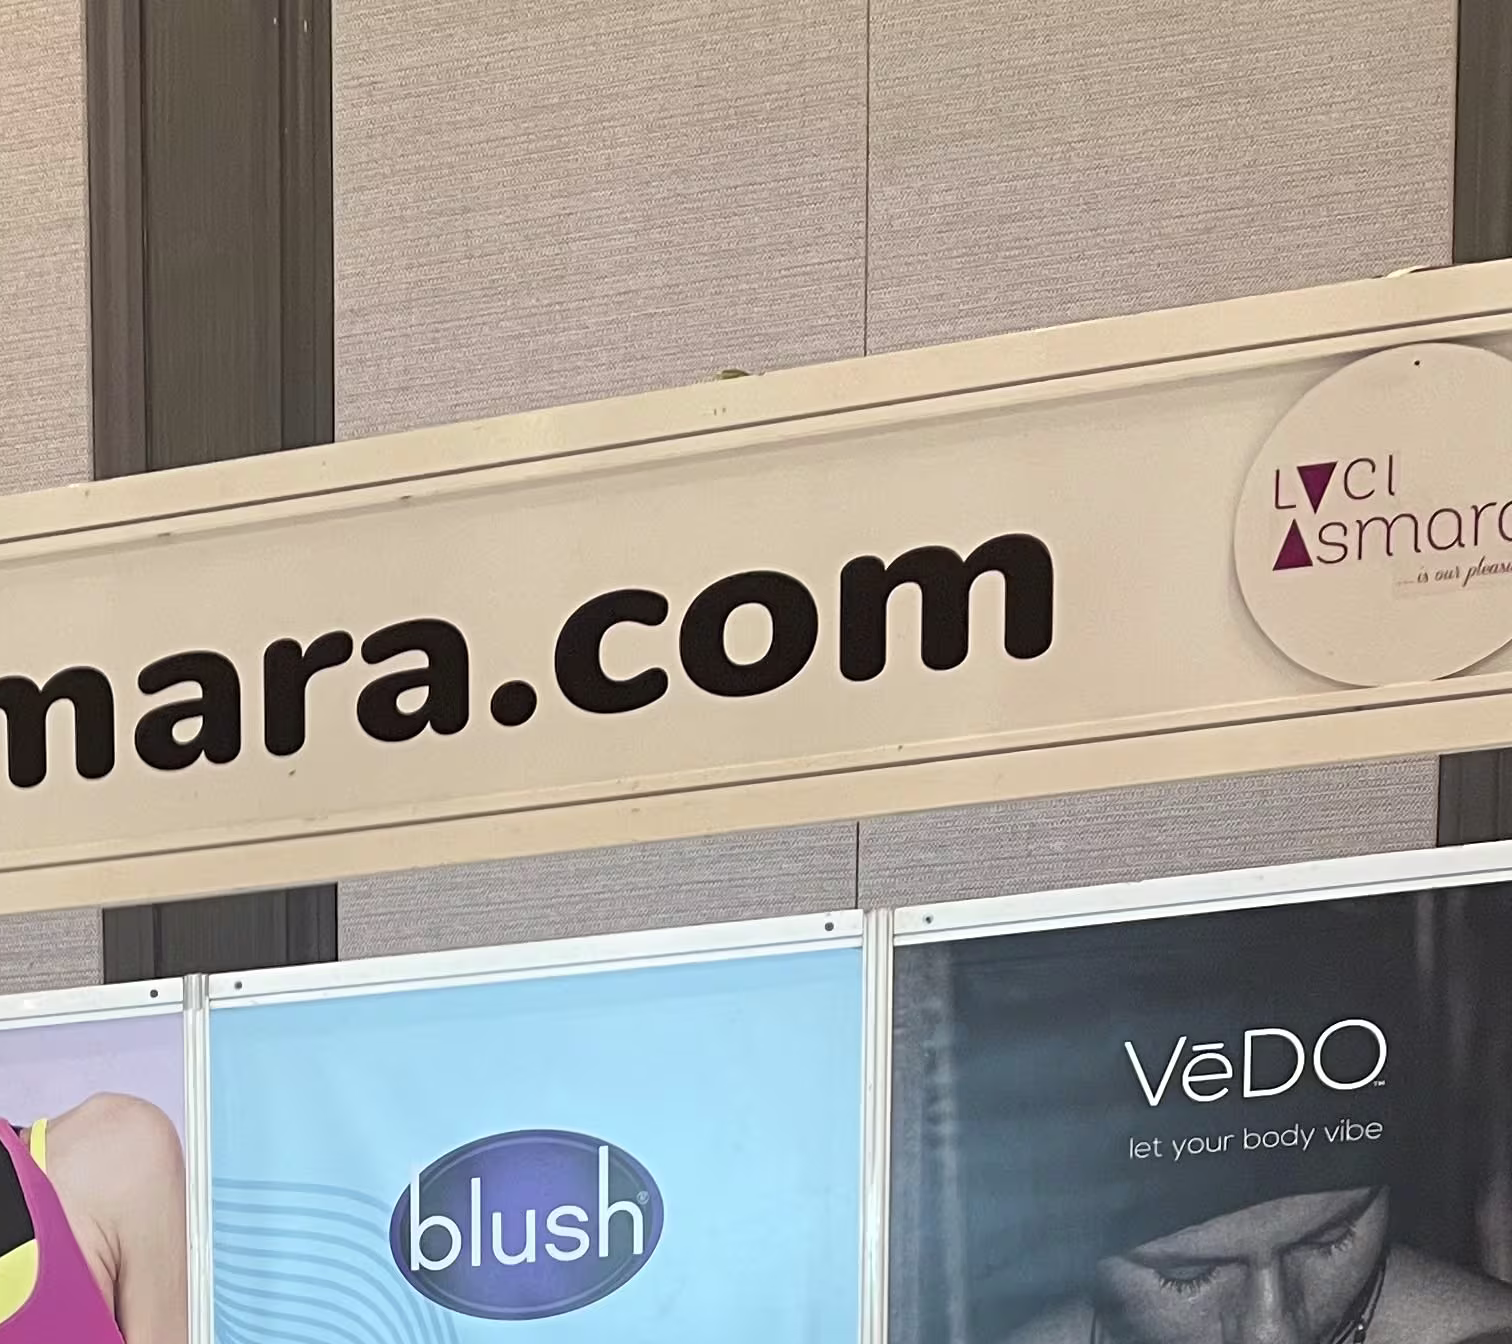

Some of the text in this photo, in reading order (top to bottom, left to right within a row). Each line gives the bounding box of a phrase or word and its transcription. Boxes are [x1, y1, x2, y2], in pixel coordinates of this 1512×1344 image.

[1435, 566, 1460, 581] our
[1129, 1119, 1384, 1161] let your body vibe
[410, 1145, 645, 1271] blush
